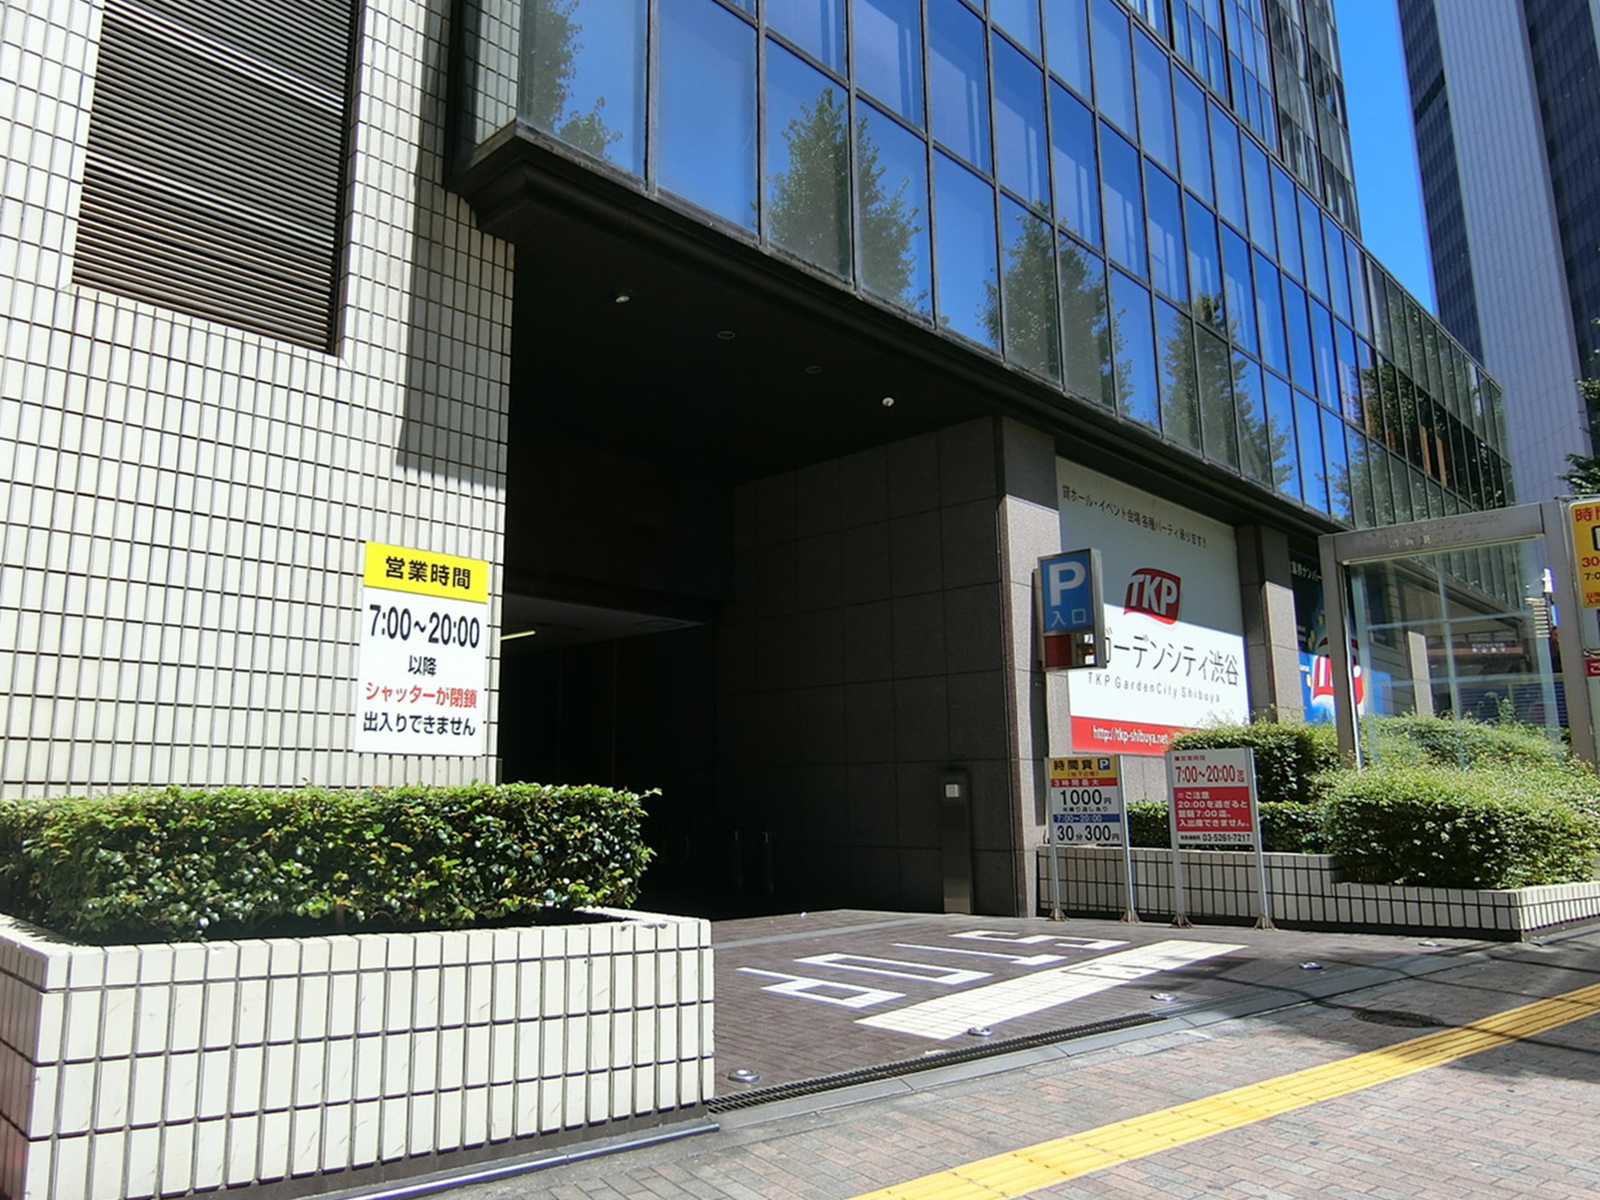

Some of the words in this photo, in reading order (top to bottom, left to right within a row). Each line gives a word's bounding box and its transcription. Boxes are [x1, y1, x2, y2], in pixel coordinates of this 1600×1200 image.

[385, 556, 471, 590] 営業時間
[1049, 560, 1086, 607] P
[1127, 574, 1179, 617] TKP
[369, 604, 480, 649] 7:00~20:00
[1051, 608, 1087, 627] 入口
[407, 655, 437, 677] 以降
[366, 682, 477, 709] シャッターが閉鎖
[1087, 671, 1111, 687] TKP
[1114, 677, 1178, 699] GardenCity
[1181, 686, 1221, 704] Shibuya
[363, 711, 476, 737] 出入りできません
[1060, 789, 1112, 805] 1000円
[1202, 833, 1251, 842] 03-5261-7217
[735, 930, 1131, 1008] STOP
